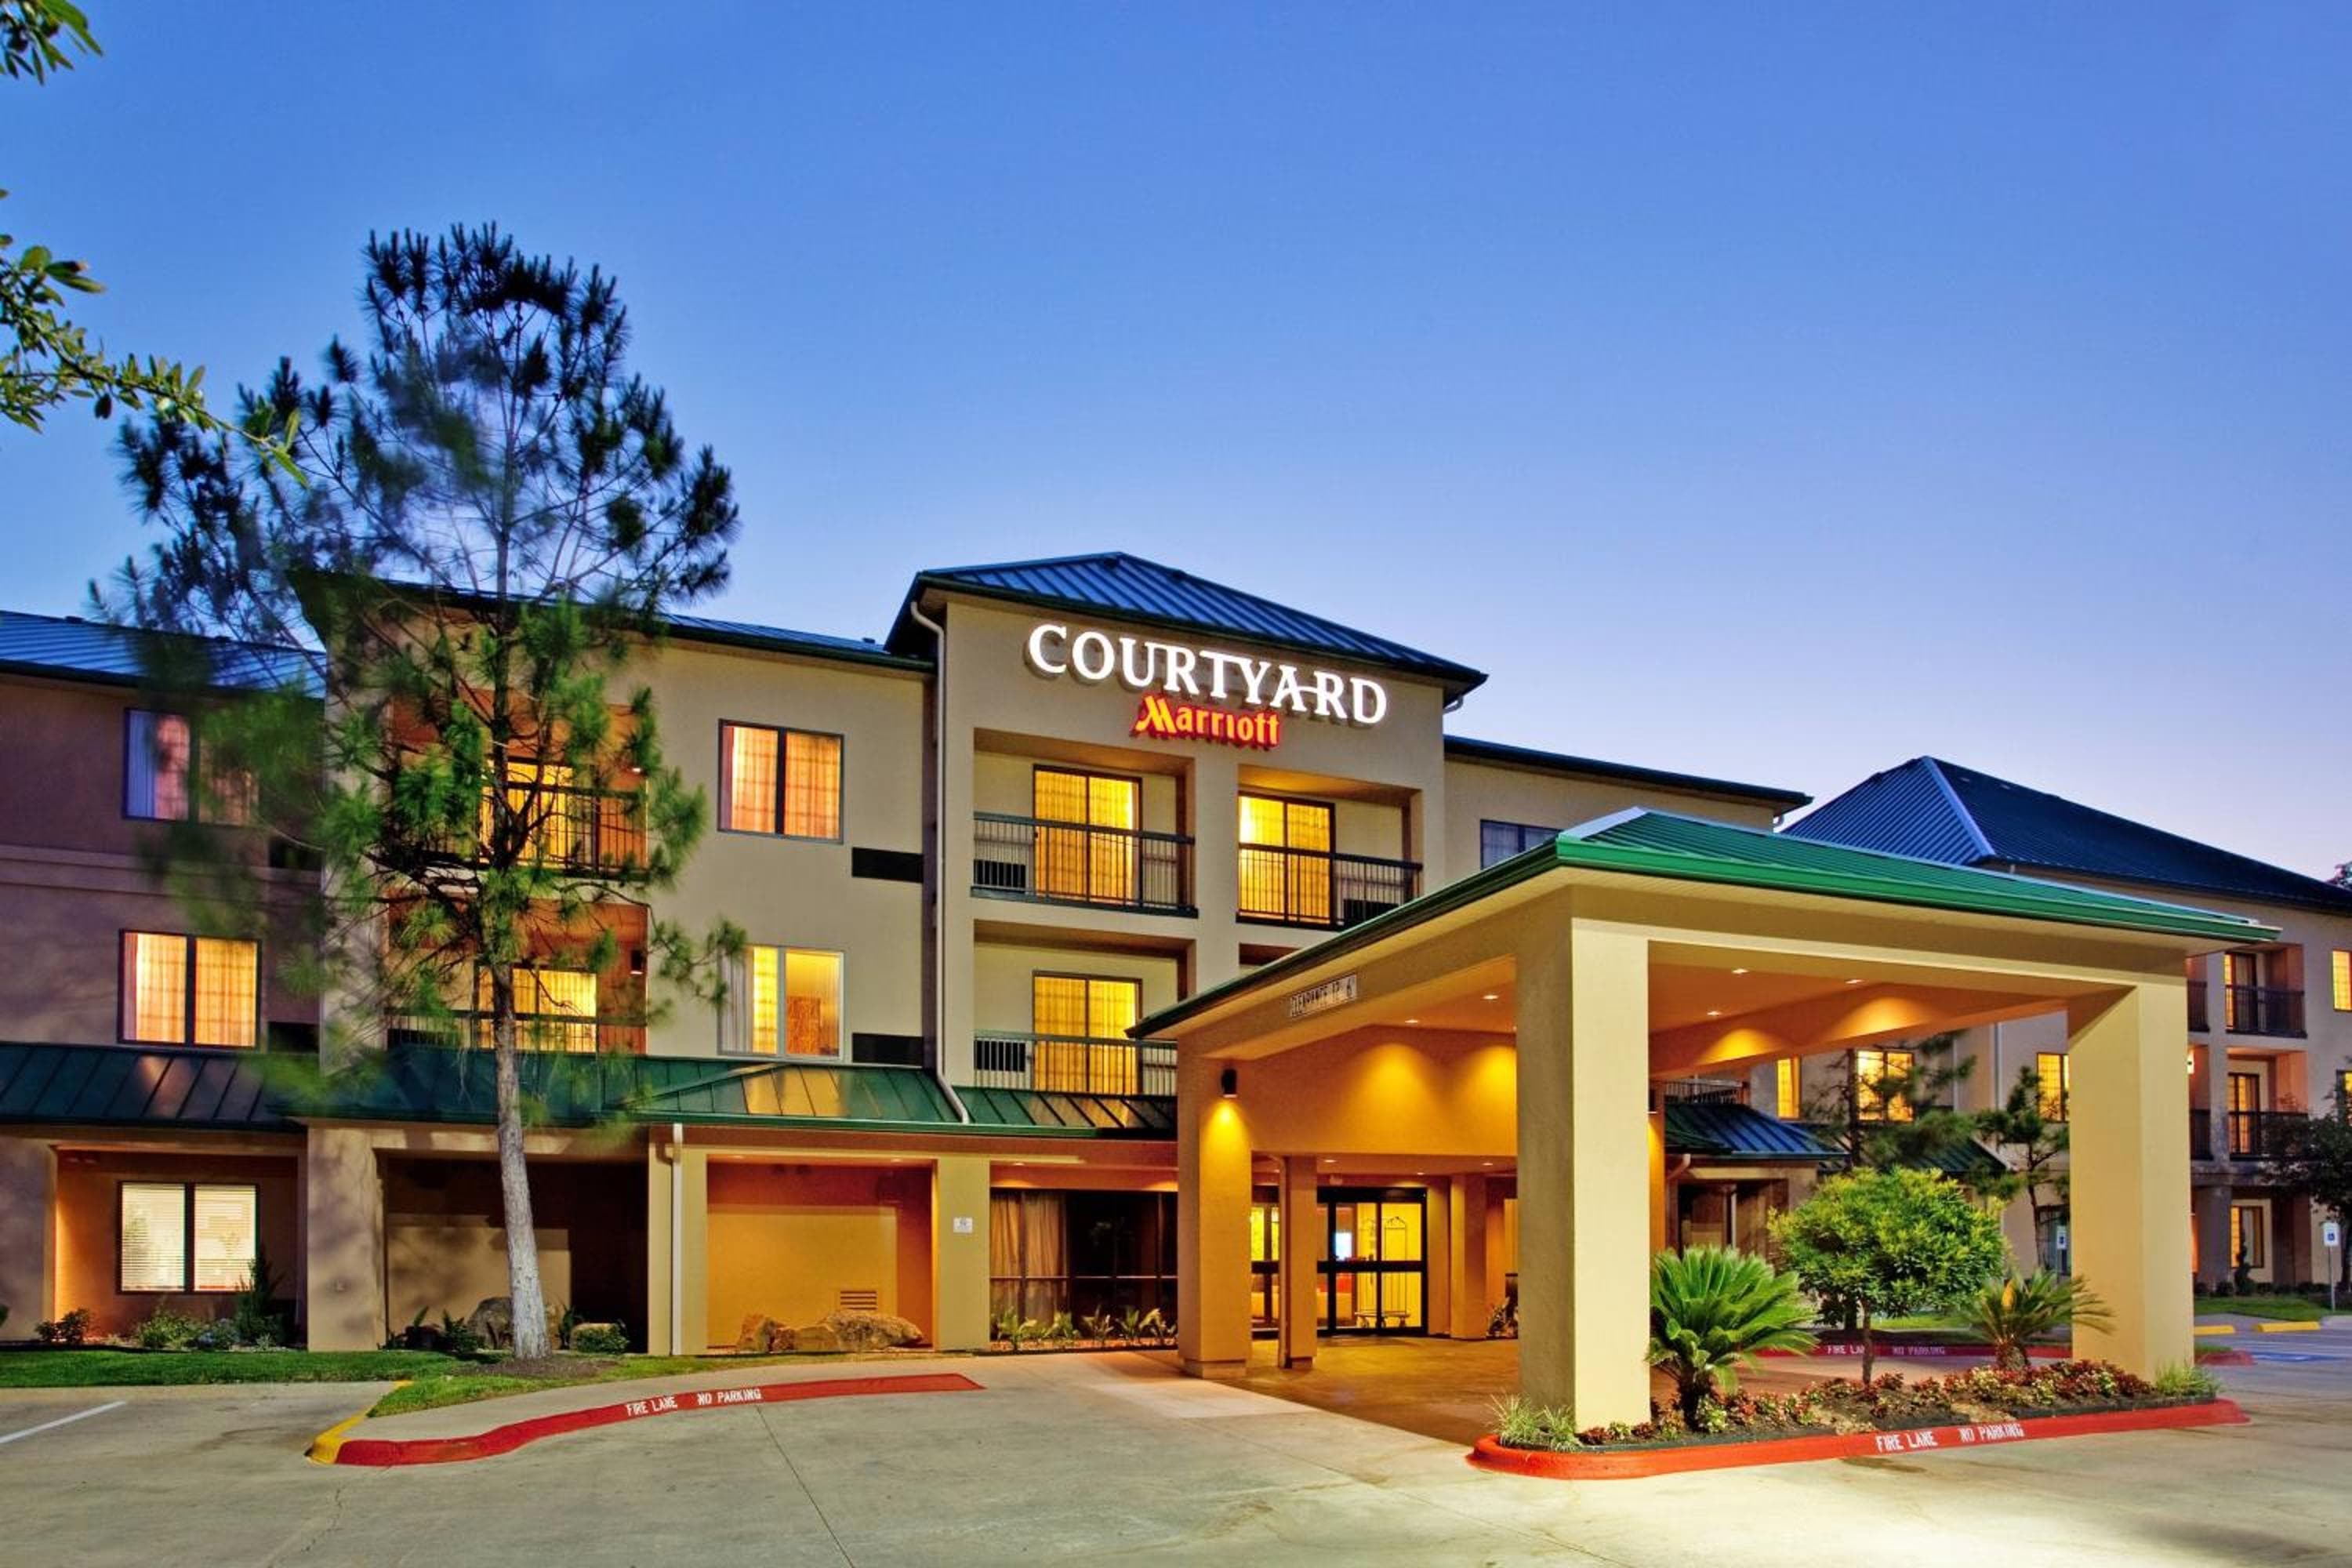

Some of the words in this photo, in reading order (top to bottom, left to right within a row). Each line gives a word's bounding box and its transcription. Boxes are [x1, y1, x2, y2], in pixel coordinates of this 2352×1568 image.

[1027, 624, 1388, 724] COURTYARD
[1132, 694, 1281, 749] Marriott
[626, 1402, 648, 1416] FIRE
[652, 1396, 678, 1412] LANE
[696, 1392, 713, 1406] NO
[717, 1388, 762, 1403] PARKING
[1875, 1433, 1904, 1451] FIRE
[1906, 1431, 1939, 1448] LANE
[1958, 1427, 1976, 1443] NO
[1978, 1423, 2024, 1441] PARKING
